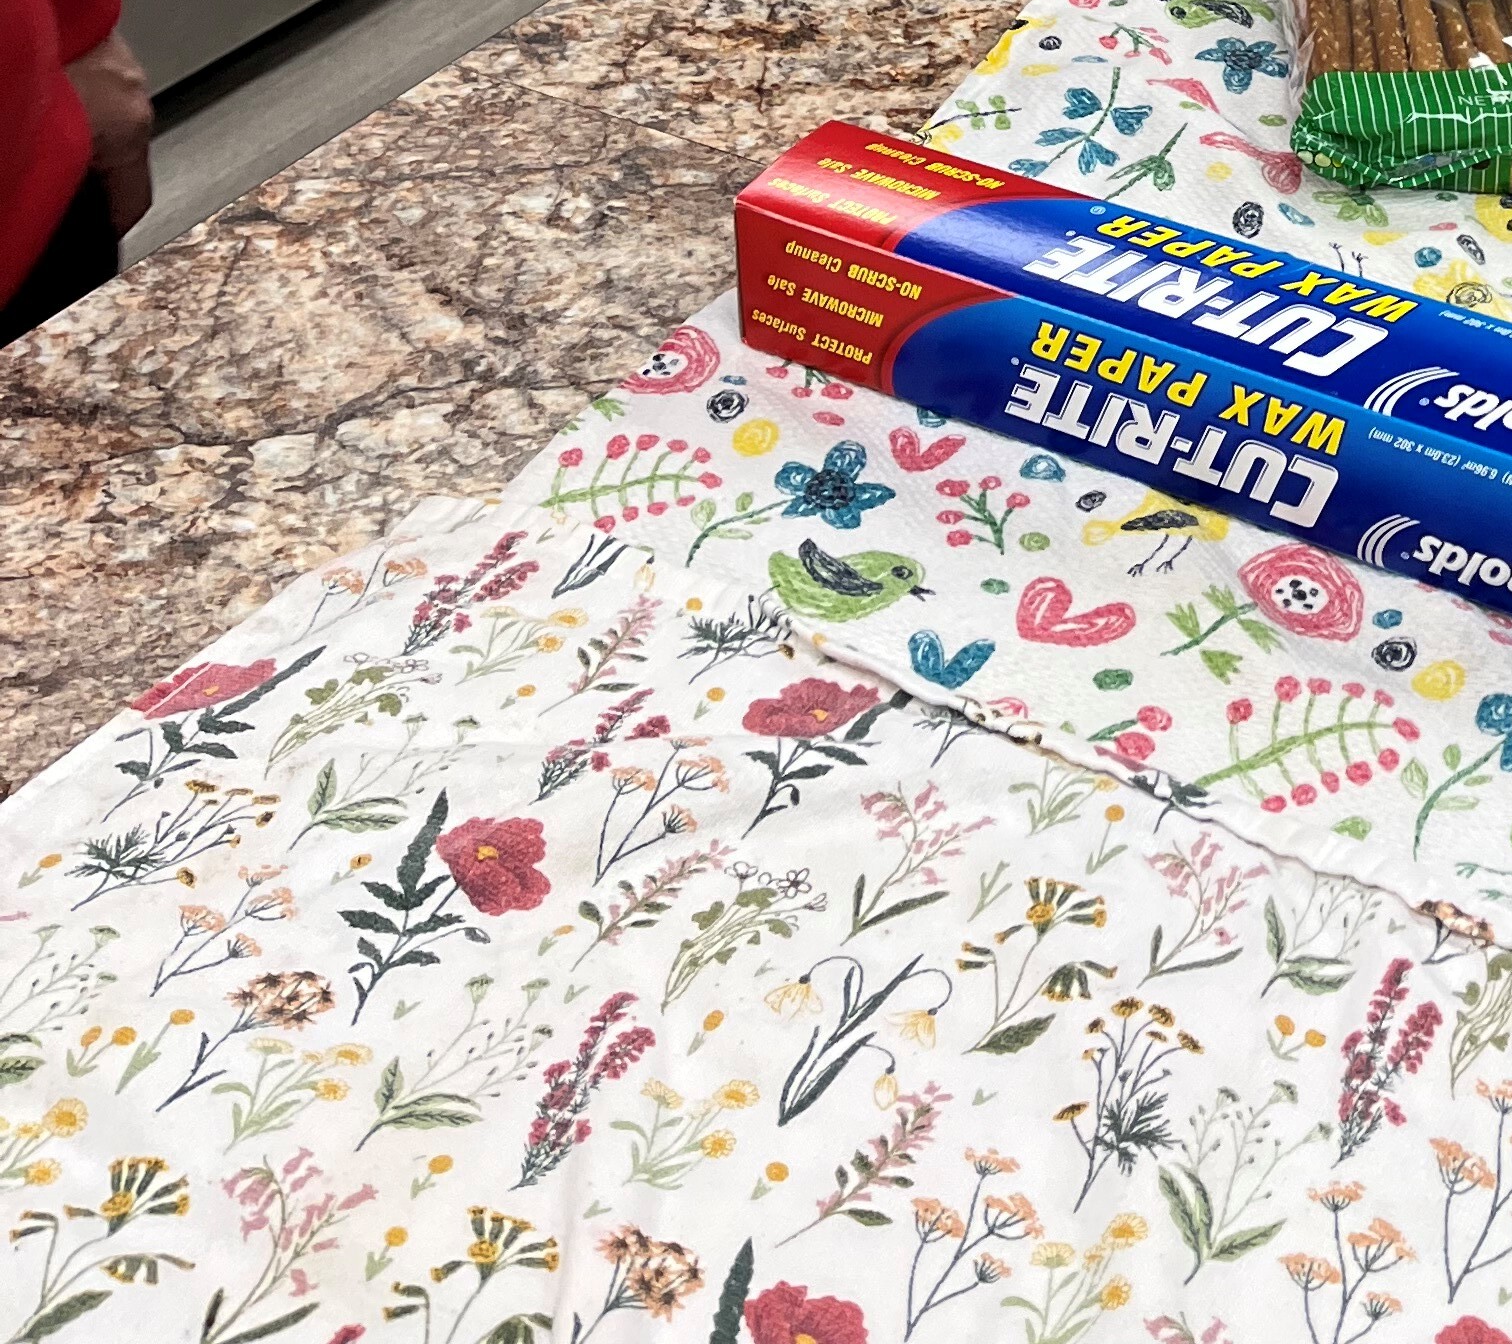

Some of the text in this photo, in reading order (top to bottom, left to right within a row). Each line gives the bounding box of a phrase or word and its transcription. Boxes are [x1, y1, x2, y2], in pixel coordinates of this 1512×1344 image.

[850, 168, 941, 201] MICROWAVE
[925, 162, 1005, 190] NO-SCRUB
[827, 197, 898, 225] PROTECT
[785, 240, 923, 301] NO-SCRUB Cleanup
[1096, 215, 1420, 323] WAX PAPER
[767, 274, 884, 328] MICROWAVE Safe
[1022, 234, 1389, 377] CUT-RITE
[752, 309, 873, 365] PROTECT Surfaces
[1030, 320, 1346, 456] WAX PAPER
[1004, 363, 1340, 529] CUT-RITE
